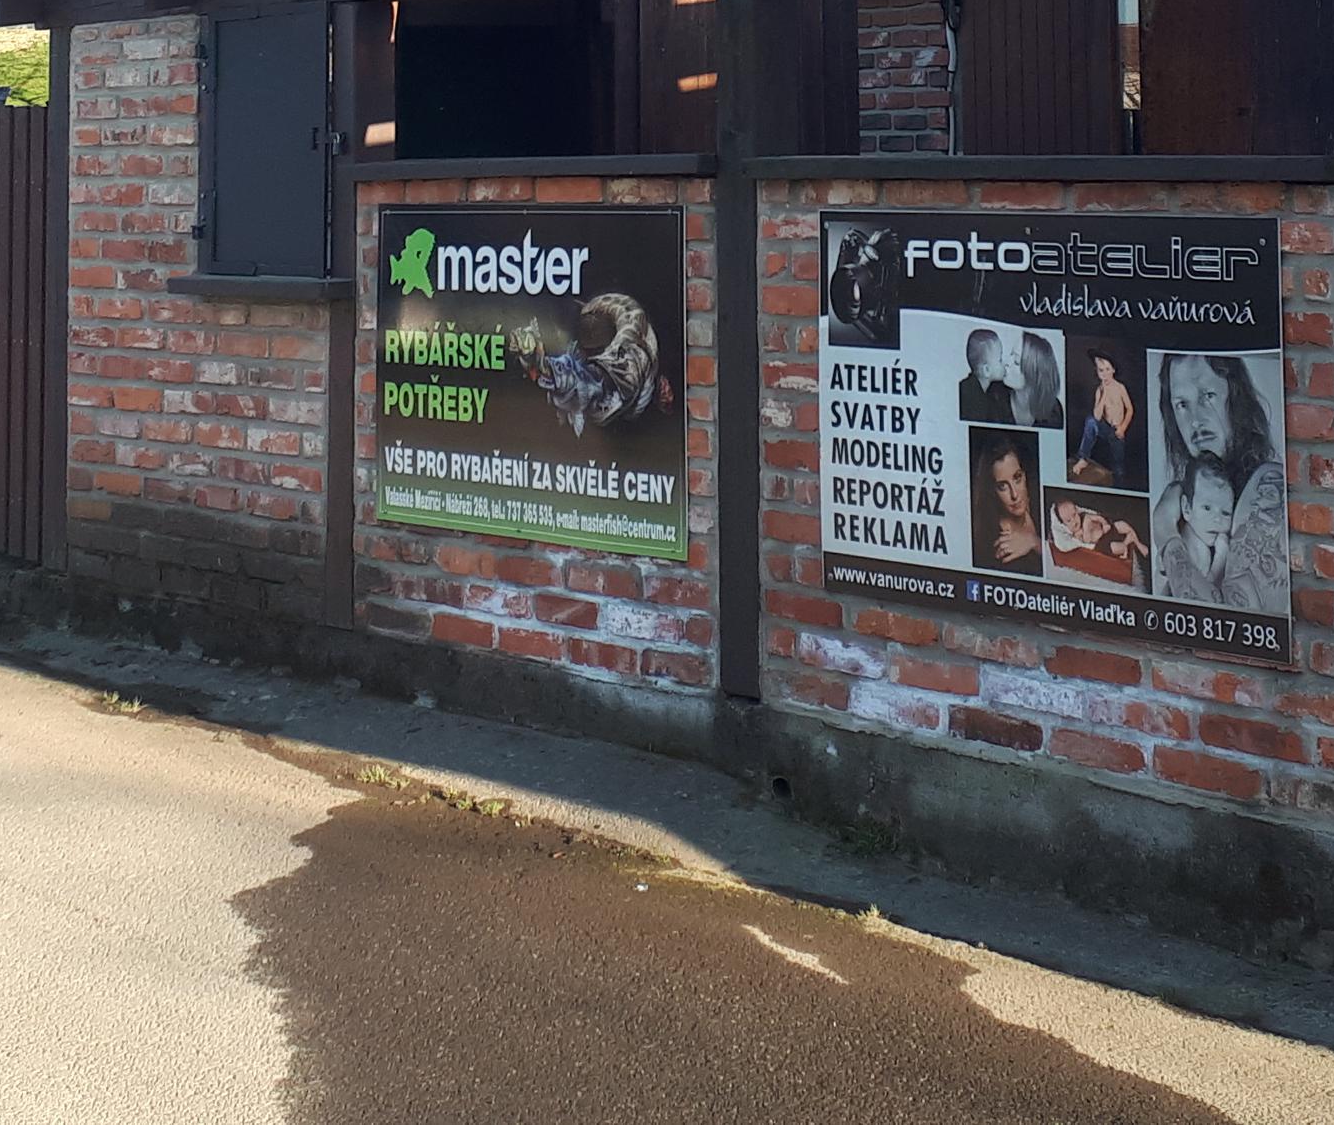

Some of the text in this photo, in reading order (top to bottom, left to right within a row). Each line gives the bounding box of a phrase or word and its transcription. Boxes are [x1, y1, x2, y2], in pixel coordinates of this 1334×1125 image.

[437, 228, 589, 295] master
[1020, 282, 1256, 326] vladislava vaňurová
[385, 321, 505, 370] RYBÁŘSKÉ
[384, 374, 489, 424] POTŘEBY
[830, 359, 919, 397] ATELIÉR
[831, 400, 921, 435] SVATBY
[384, 439, 675, 504] VŠE PRO RYBAŘENÍ ZA SKVĚLÉ CENY
[831, 437, 944, 475] MODELING
[473, 496, 491, 522] 268,
[507, 500, 521, 522] 737
[522, 501, 538, 525] 365
[539, 504, 555, 531] 535,
[580, 513, 676, 542] masterfish@centrum.cz
[833, 476, 946, 517] REPORTÁŽ
[834, 512, 948, 555] REKLAMA
[833, 566, 955, 598] www.vanurova.cz
[984, 584, 1075, 617] FOTOateliér
[1079, 598, 1136, 627] Vlaďka
[1164, 612, 1197, 637] 603
[1203, 617, 1236, 643] 817
[1242, 623, 1277, 651] 398
